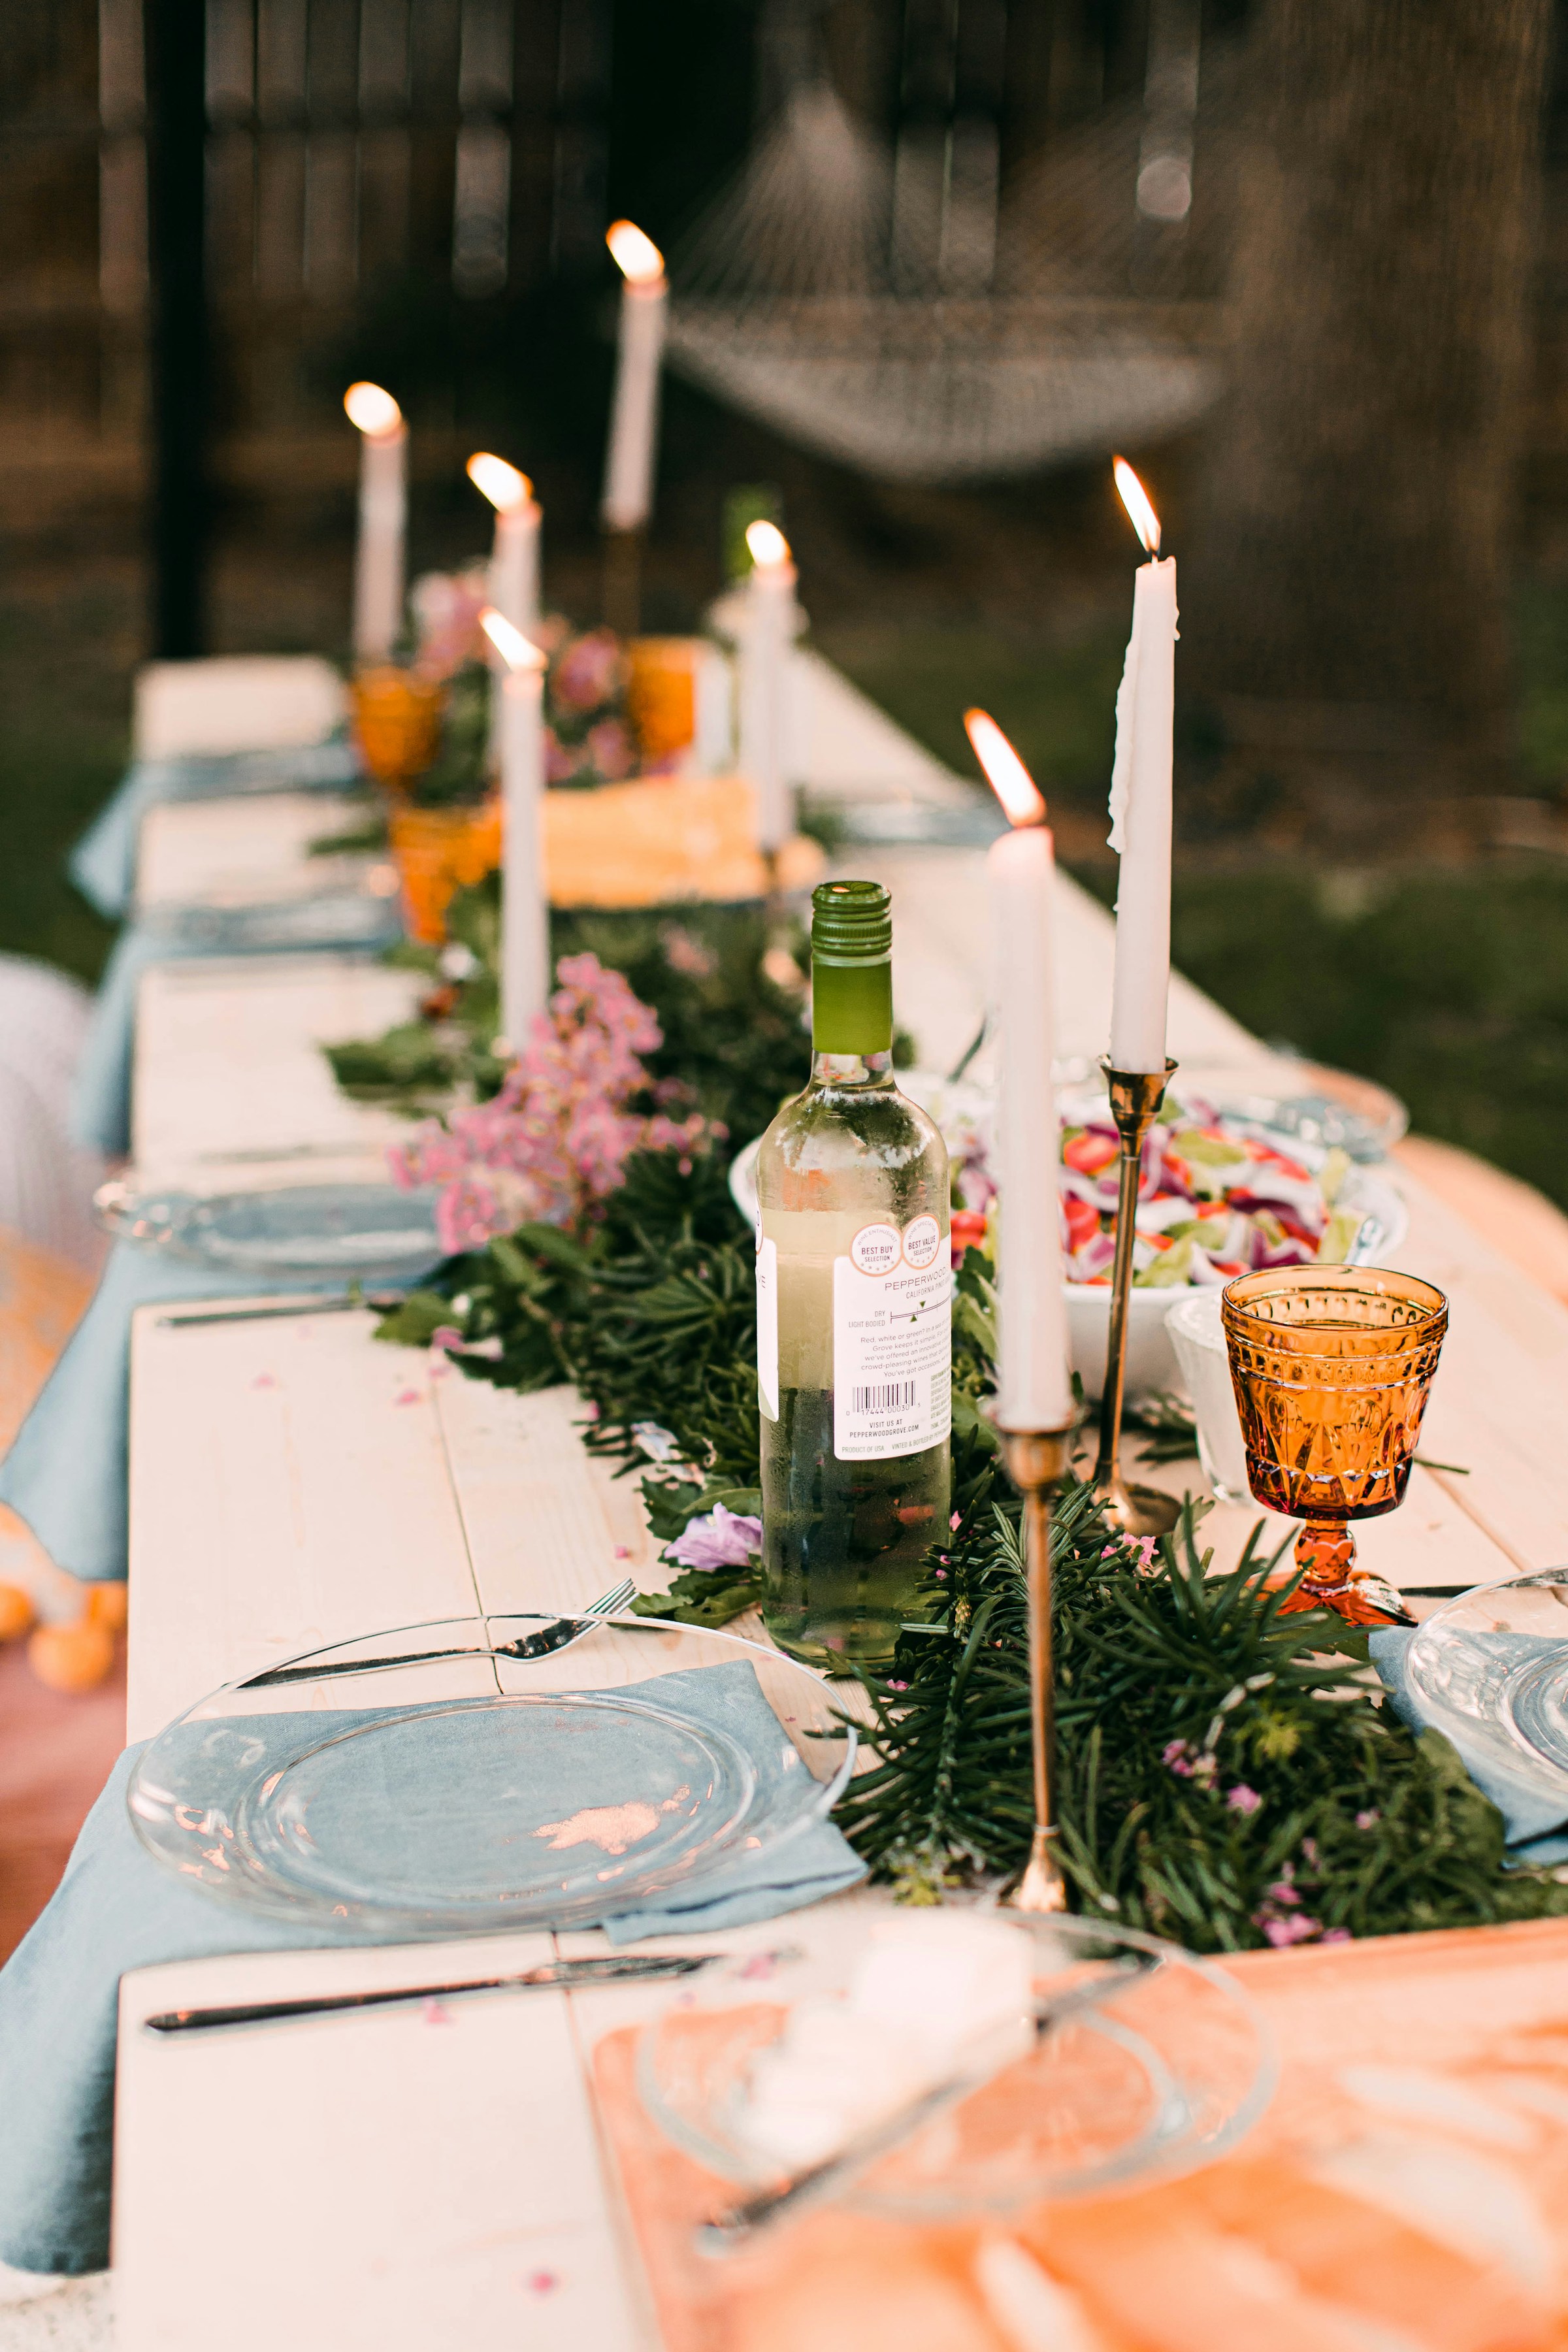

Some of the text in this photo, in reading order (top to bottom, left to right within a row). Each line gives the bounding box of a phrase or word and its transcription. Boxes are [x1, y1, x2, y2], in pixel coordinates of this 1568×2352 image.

[857, 1228, 898, 1246] WINE ENTHUSIAST
[908, 1226, 917, 1240] WINE
[880, 1245, 893, 1254] BUY
[908, 1235, 936, 1250] BEST VALUE
[913, 1247, 932, 1256] SELECTION
[906, 1285, 934, 1299] CALIFORNIA
[906, 1328, 925, 1340] green?
[886, 1350, 909, 1360] offered
[919, 1340, 941, 1353] innovative
[894, 1340, 913, 1349] keeps
[861, 1358, 912, 1371] crowd-pleasing
[913, 1354, 928, 1364] wines
[887, 1404, 910, 1414] 00030
[849, 1424, 919, 1438] PEPPERWOODGROVE.COM
[892, 1441, 908, 1450] VINTED
[913, 1435, 929, 1446] BOTTLED
